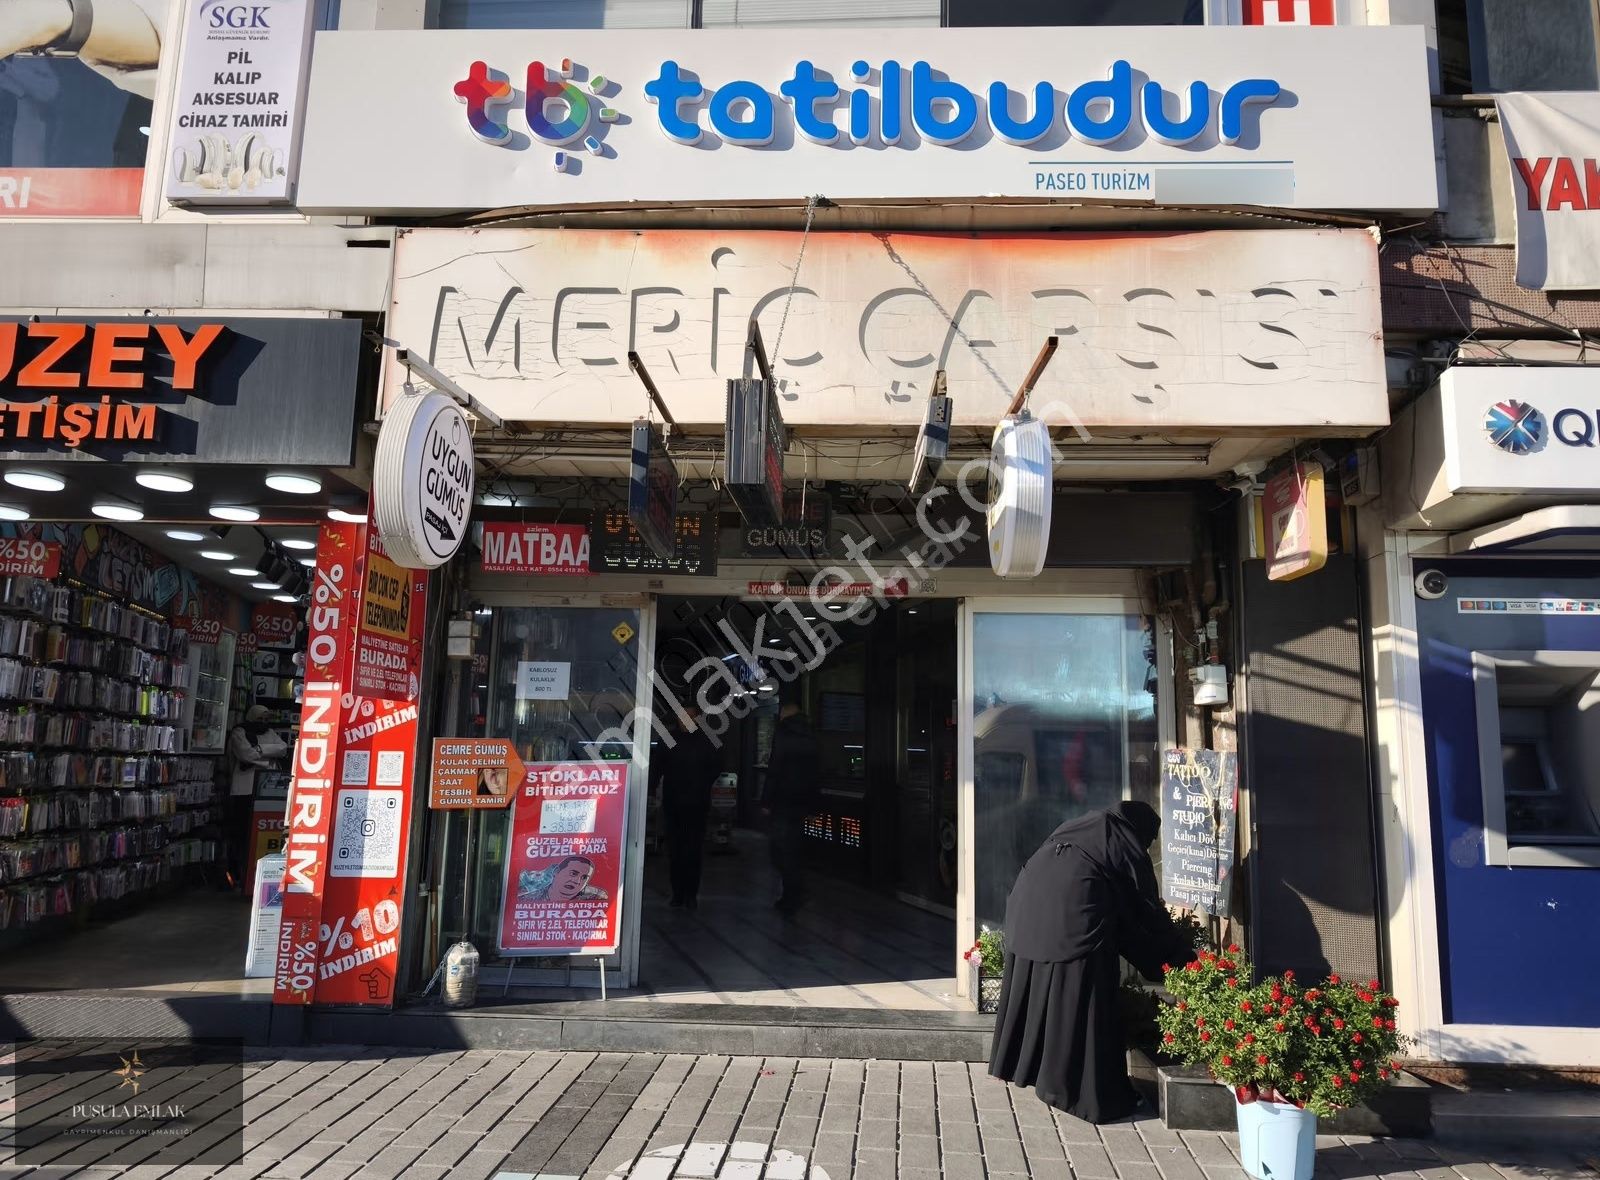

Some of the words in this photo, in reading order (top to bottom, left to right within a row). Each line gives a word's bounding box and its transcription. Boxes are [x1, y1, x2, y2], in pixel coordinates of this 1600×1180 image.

[210, 6, 271, 28] SGK
[227, 48, 253, 64] PİL
[213, 72, 262, 85] KALIP
[192, 92, 279, 105] AKSESUAR
[644, 59, 1281, 146] tatilbudur
[178, 112, 228, 127] CİHAZ
[232, 110, 288, 127] TAMİRİ
[1035, 172, 1086, 191] PASEO
[1091, 168, 1151, 191] TURİZM
[0, 395, 157, 447] TİŞİM
[1553, 407, 1600, 448] Q
[431, 430, 472, 493] UYGUN
[426, 467, 466, 526] GÜMÜŞ
[485, 531, 591, 566] MATBAA
[310, 563, 344, 665] %50
[360, 648, 408, 671] BURADA
[344, 705, 418, 744] İNDİRİM
[440, 744, 472, 755] CEMRE
[286, 681, 340, 893] İNDİRİM
[526, 769, 620, 783] STOKLARI
[1173, 786, 1182, 800] &
[1186, 794, 1233, 810] PIERNG
[579, 843, 607, 855] PARA
[514, 909, 608, 919] BURADA
[319, 899, 400, 957] %10
[545, 931, 566, 940] STOK
[319, 936, 397, 981] İNDİRİM
